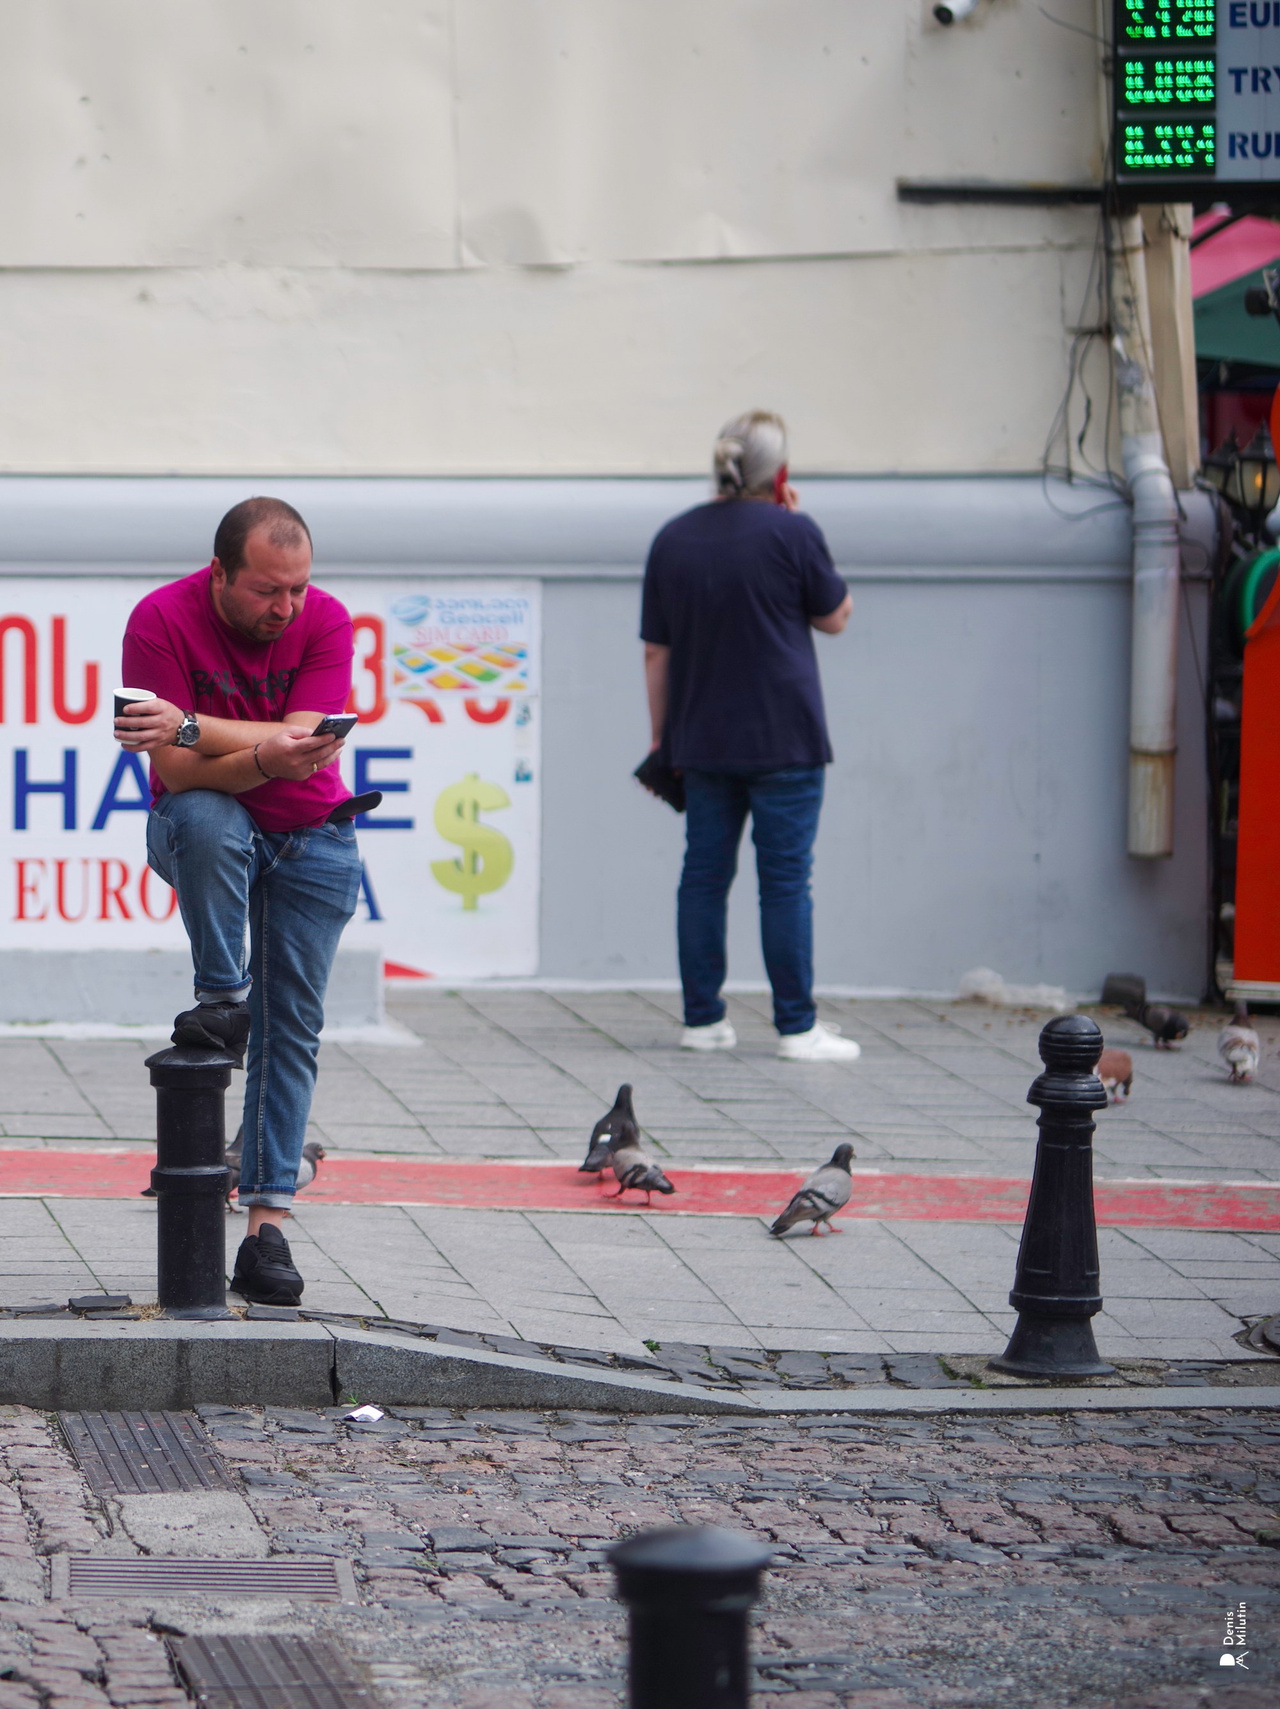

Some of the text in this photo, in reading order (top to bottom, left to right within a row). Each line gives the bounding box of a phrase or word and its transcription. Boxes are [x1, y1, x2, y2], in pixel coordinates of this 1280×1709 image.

[440, 610, 524, 625] Geocell
[415, 626, 510, 641] SIM CARD
[11, 857, 179, 923] EURO
